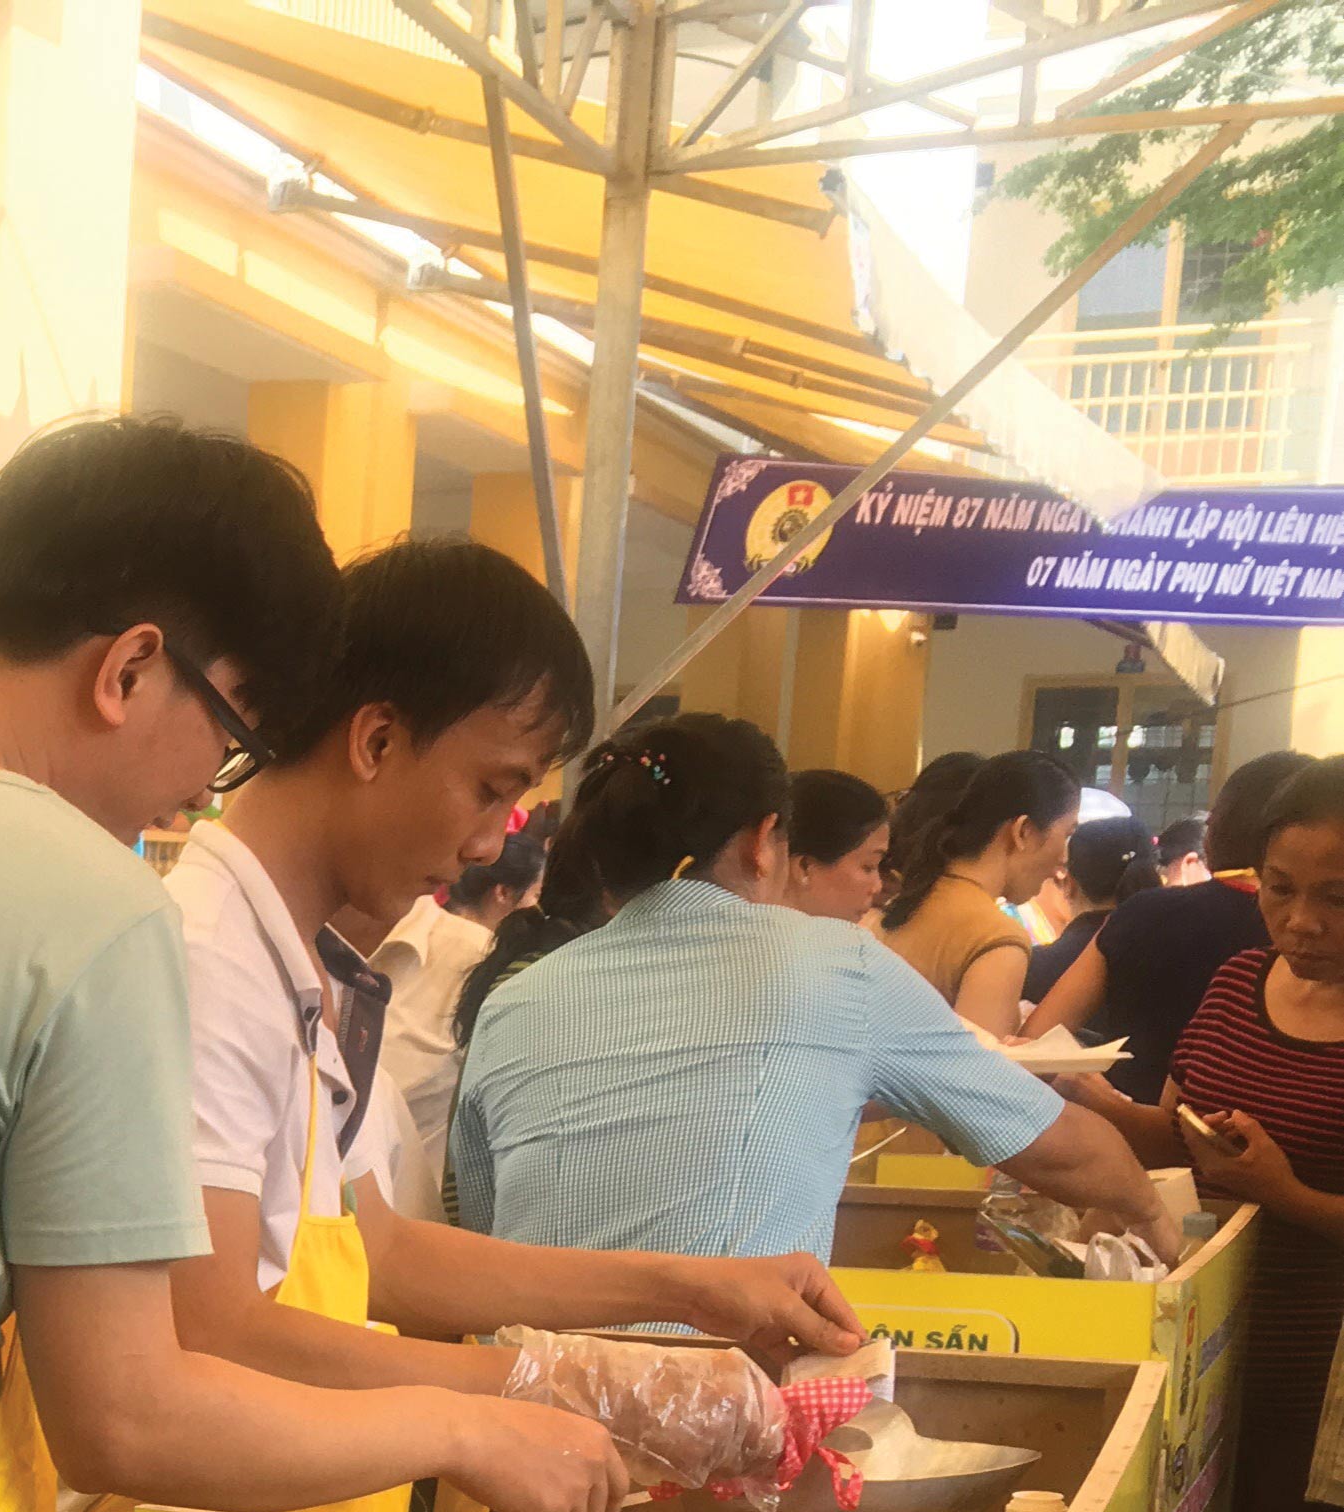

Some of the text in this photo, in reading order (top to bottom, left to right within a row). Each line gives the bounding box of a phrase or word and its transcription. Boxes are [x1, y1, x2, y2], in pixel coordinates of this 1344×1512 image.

[855, 481, 894, 524] KỶ
[892, 487, 954, 536] NIỆM
[952, 496, 985, 528] 87
[982, 492, 1038, 531] NĂM
[1174, 500, 1223, 549] LẬP
[1217, 502, 1263, 550] HỘI
[1258, 504, 1315, 544] LIÊN
[1026, 555, 1059, 588] 07
[1055, 550, 1110, 591] NĂM
[1105, 551, 1174, 592] NGÀY
[1167, 561, 1219, 604] PHỤ
[1214, 555, 1257, 597] NỮ
[1250, 558, 1304, 606] VIỆT
